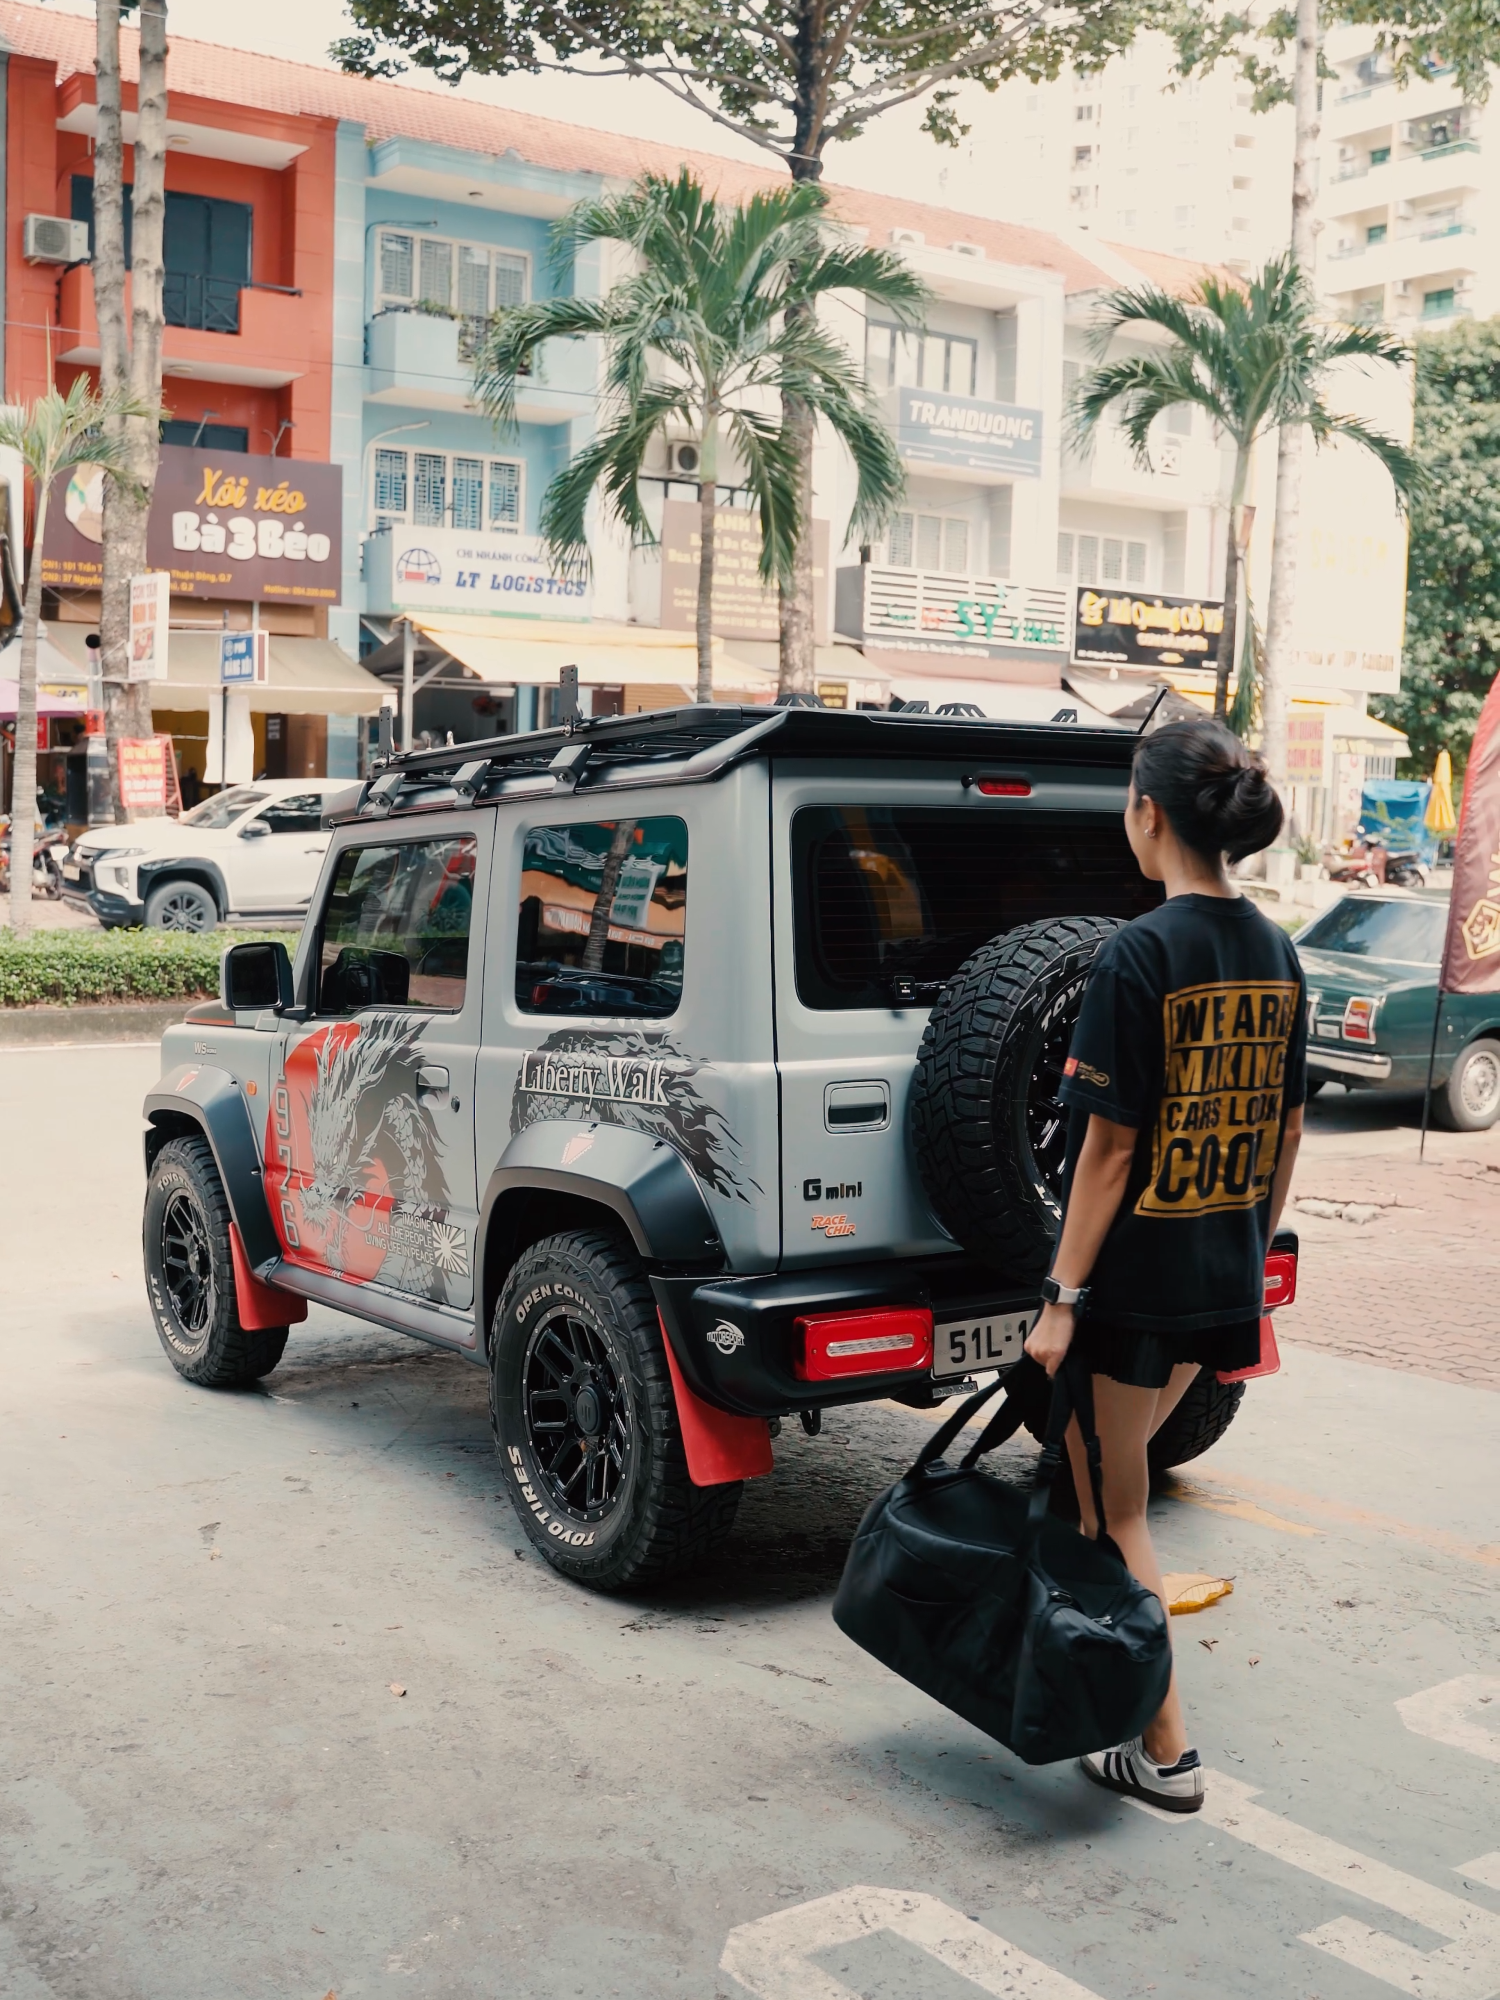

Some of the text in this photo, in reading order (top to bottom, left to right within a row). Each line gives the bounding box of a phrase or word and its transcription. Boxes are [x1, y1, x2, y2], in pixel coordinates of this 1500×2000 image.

[195, 467, 307, 514] Xôi xéo
[455, 571, 480, 588] LT
[1175, 995, 1226, 1043] WE
[520, 1050, 670, 1112] Liberty Walk
[1167, 1044, 1285, 1095] MAKING
[1166, 1097, 1222, 1132] CARS
[276, 1041, 299, 1247] 1976
[803, 1178, 821, 1201] G
[378, 1221, 433, 1248] ALL THE PEOPLE
[402, 1212, 431, 1232] IMAGINE
[812, 1214, 847, 1229] RACE
[825, 1224, 856, 1238] CHIP
[365, 1233, 435, 1265] LIVING LIFE IN PEACE
[515, 1284, 552, 1324] OPEN
